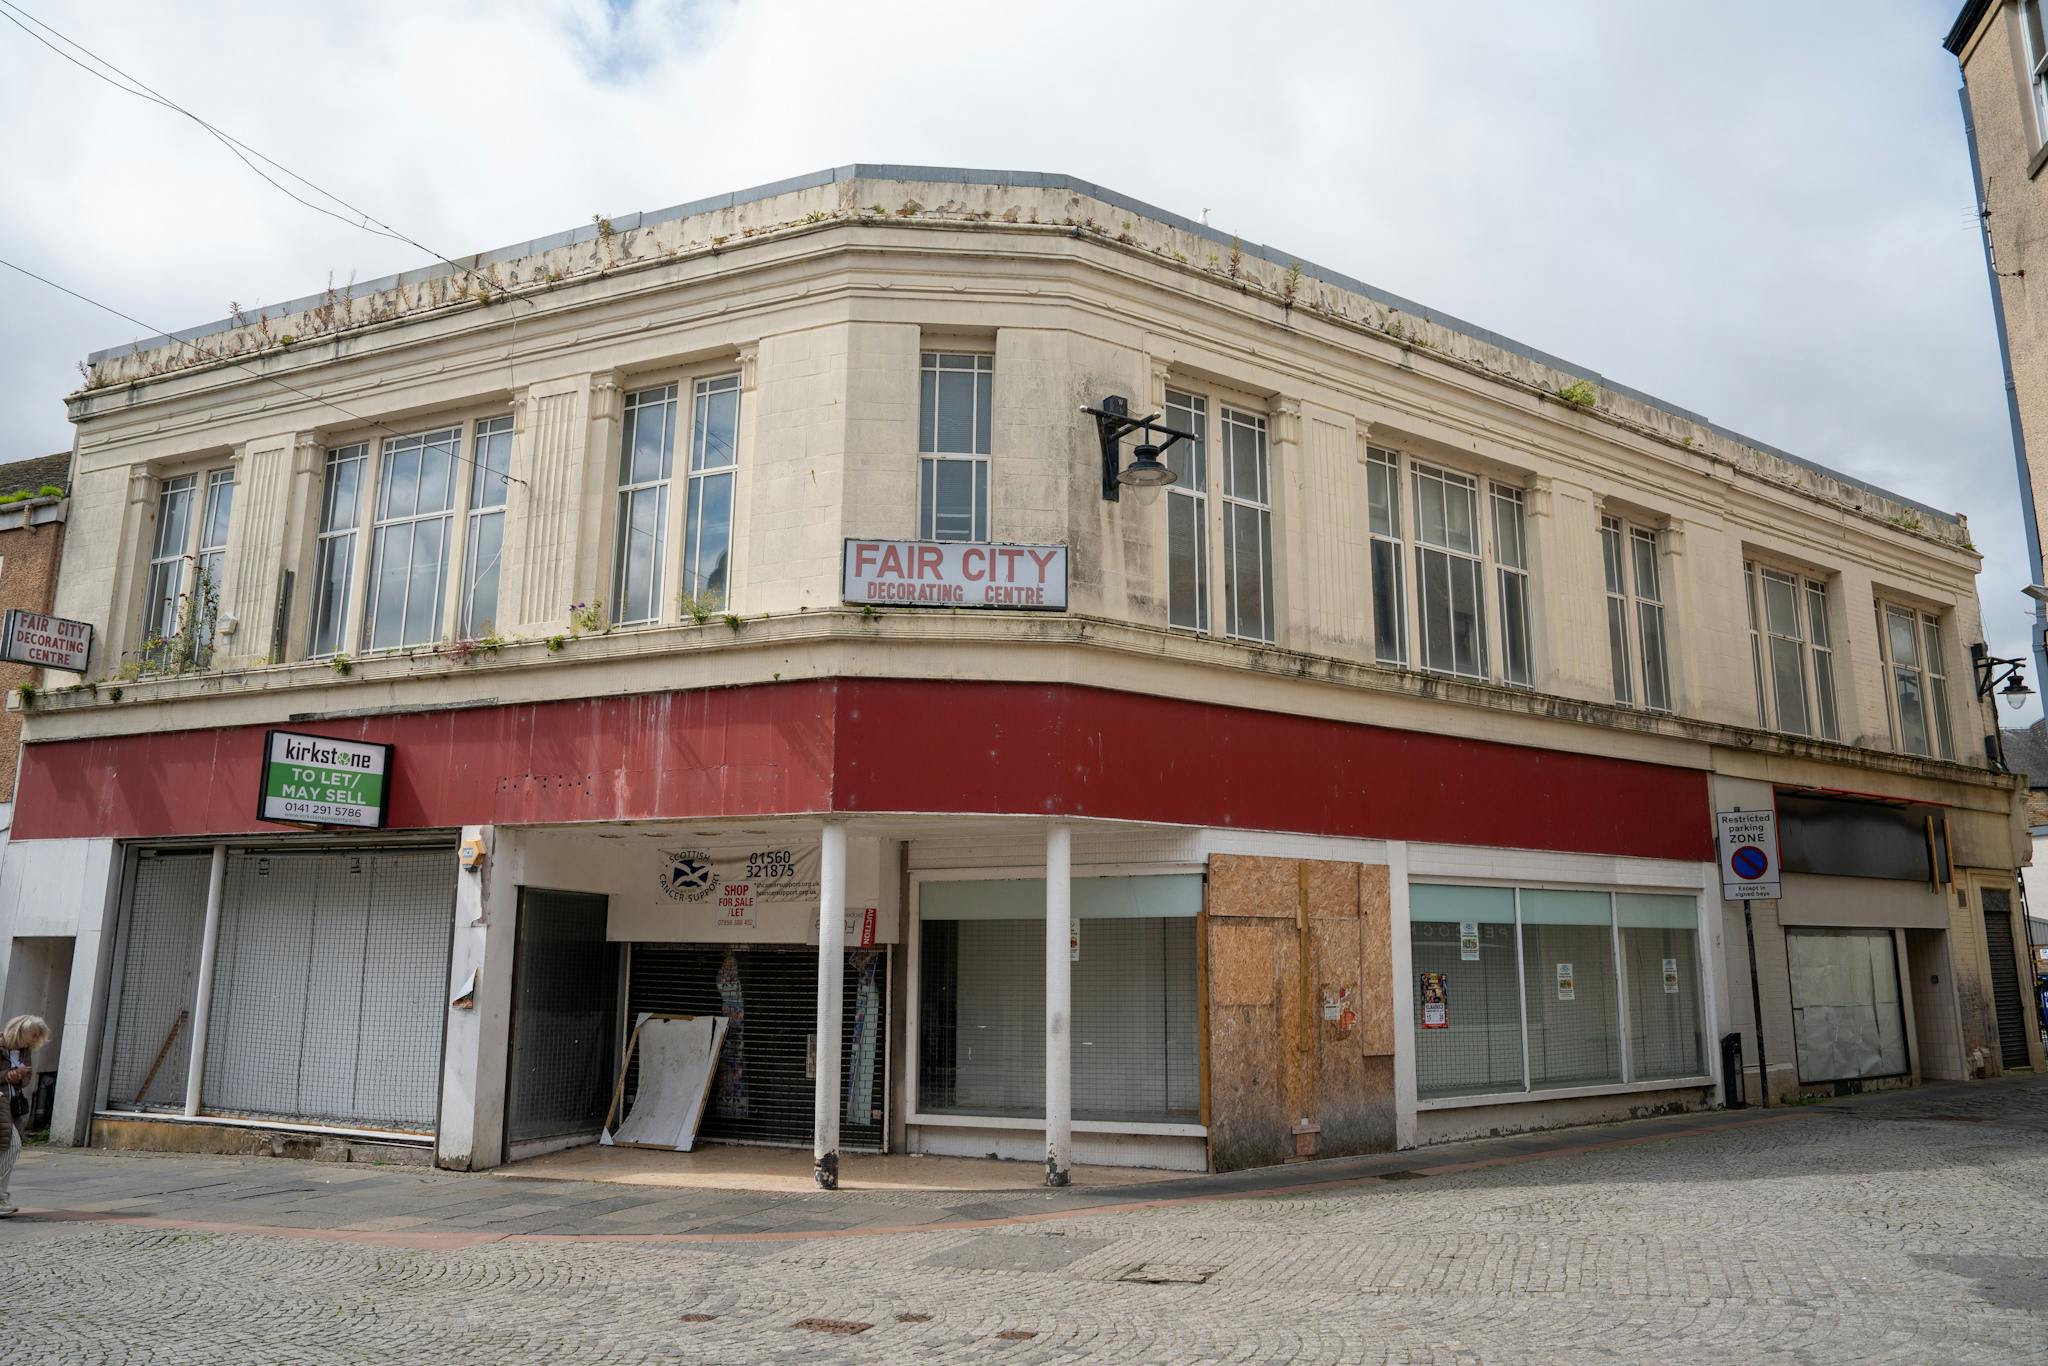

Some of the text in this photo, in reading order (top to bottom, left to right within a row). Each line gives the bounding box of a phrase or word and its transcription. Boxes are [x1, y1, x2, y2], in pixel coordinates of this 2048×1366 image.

[854, 543, 1058, 584] FAIR CITY
[867, 581, 1044, 605] DECORATING CENTRE
[19, 613, 85, 639] FAIR CITY
[16, 630, 84, 654] DECORATING
[29, 647, 70, 666] CENTRE
[285, 738, 371, 768] kirkstone
[291, 767, 361, 789] TO LET/
[281, 783, 367, 805] MAY SELL
[284, 802, 362, 818] 0141 291 5786
[1721, 814, 1770, 824] Restricted
[1728, 824, 1764, 834] parking
[1729, 833, 1765, 844] ZONE
[668, 850, 711, 864] SCOTTISH
[749, 850, 791, 865] 01560
[746, 863, 794, 878] 321875
[724, 884, 749, 897] SHOP
[718, 897, 754, 907] FOR SALE
[863, 908, 875, 945] AUCTION
